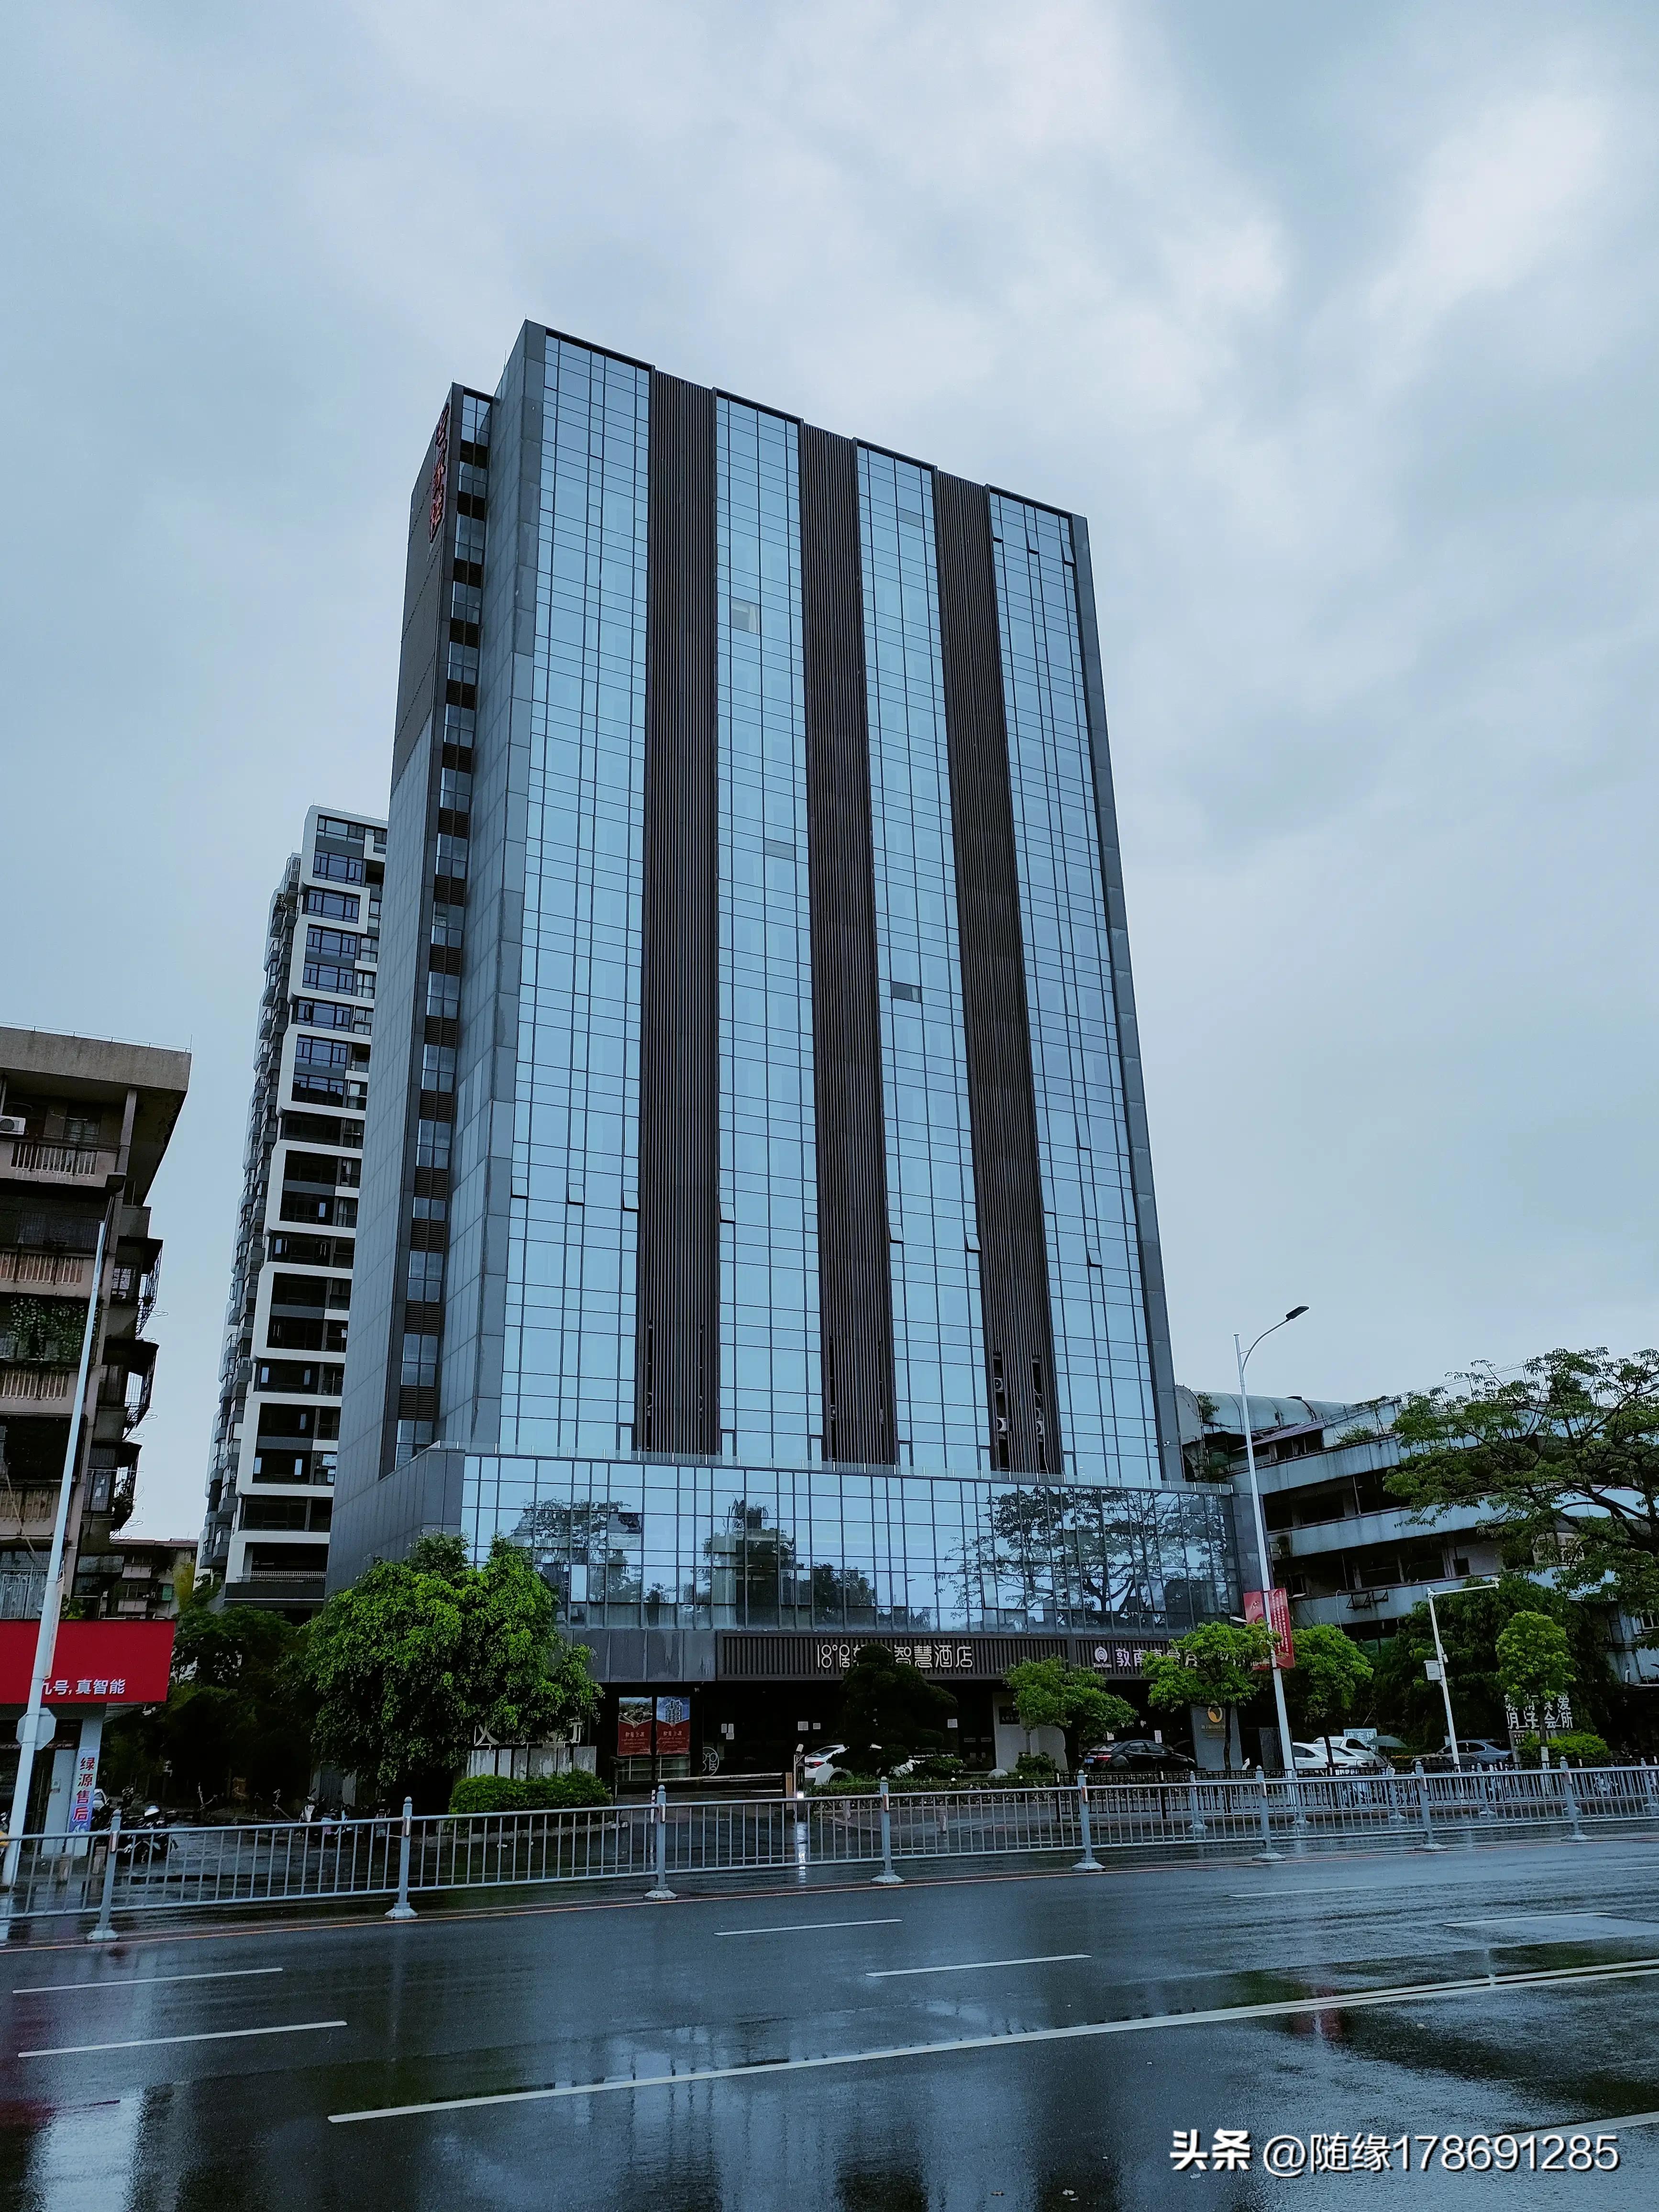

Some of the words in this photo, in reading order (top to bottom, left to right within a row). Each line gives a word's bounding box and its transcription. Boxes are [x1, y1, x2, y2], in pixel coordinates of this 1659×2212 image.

[1508, 1710, 1573, 1729] 月子会所
[73, 1757, 95, 1821] 绿源售后
